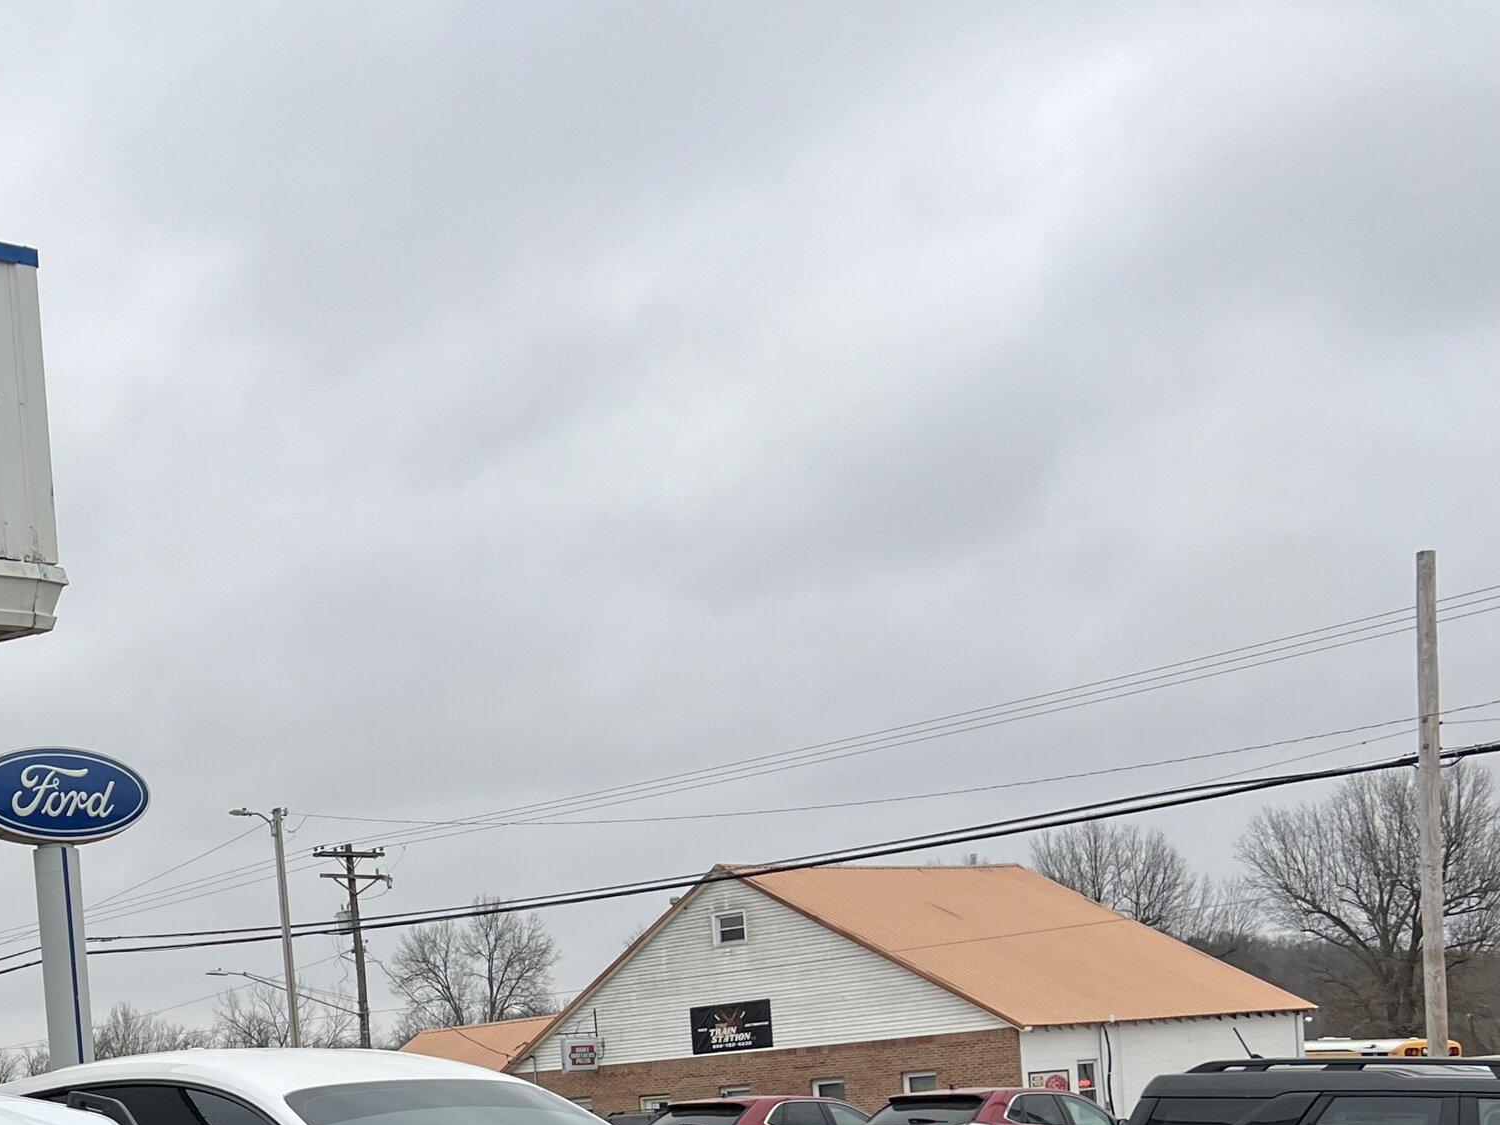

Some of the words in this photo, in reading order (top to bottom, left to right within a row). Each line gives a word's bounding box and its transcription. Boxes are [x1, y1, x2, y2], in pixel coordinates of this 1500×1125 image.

[11, 764, 115, 818] Ford
[708, 1026, 737, 1037] TRAIN
[710, 1032, 752, 1044] STATION
